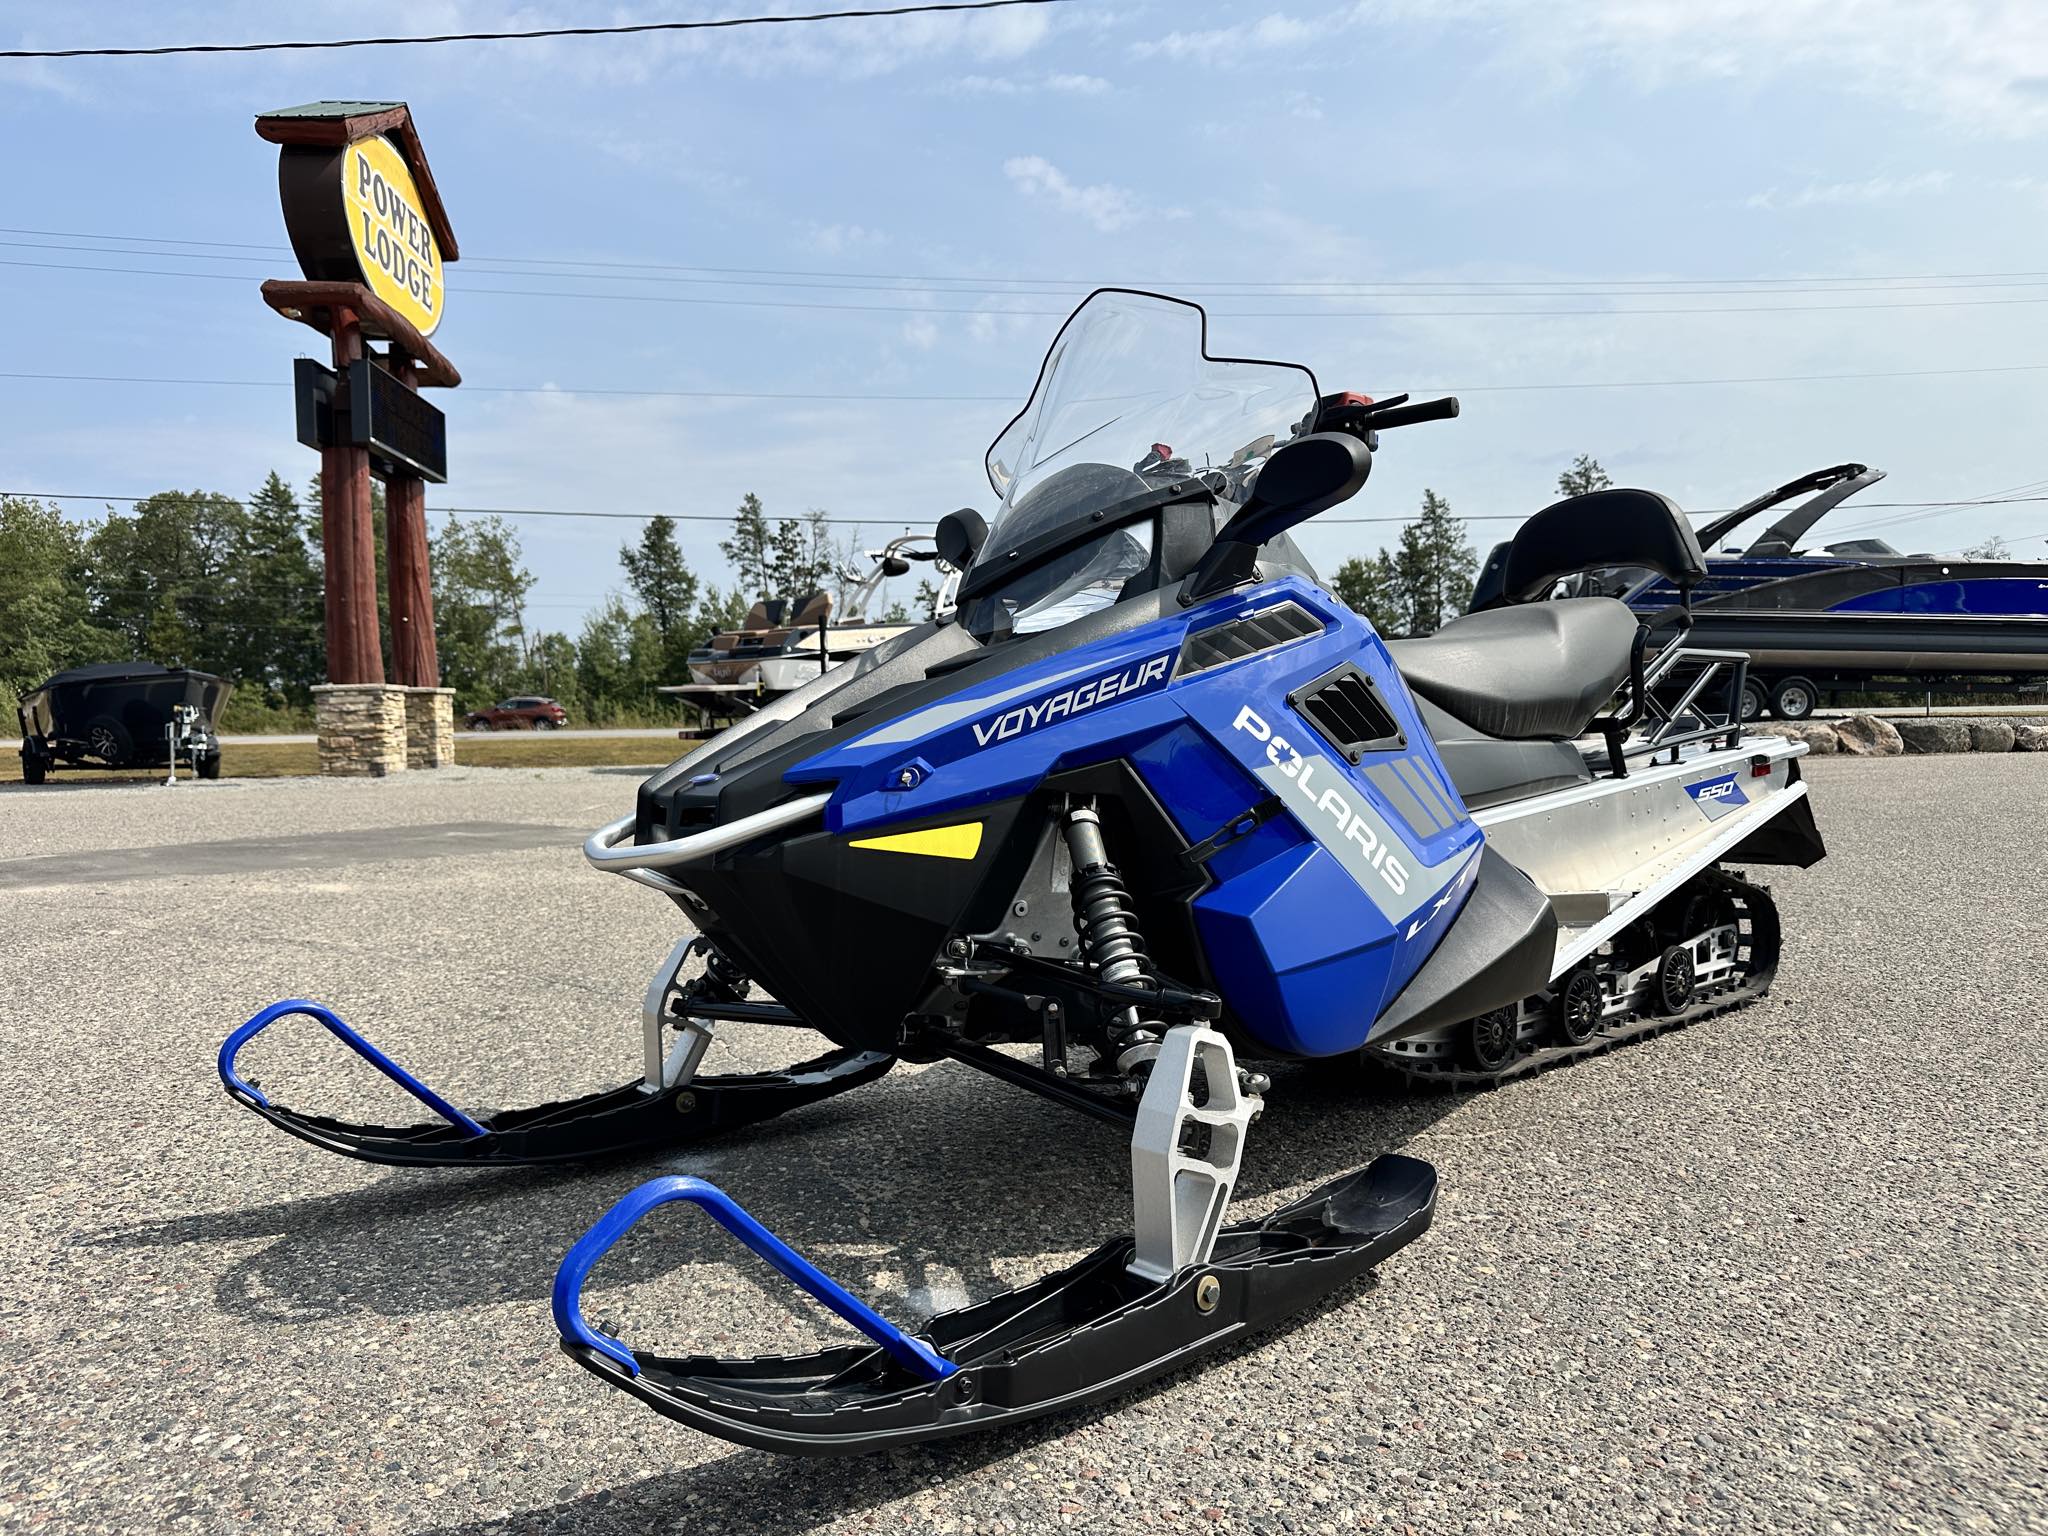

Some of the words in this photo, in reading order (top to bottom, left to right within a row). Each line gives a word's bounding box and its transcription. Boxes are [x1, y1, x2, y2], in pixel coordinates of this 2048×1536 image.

[357, 152, 433, 268] POWER
[362, 210, 433, 312] LODGE
[972, 654, 1170, 747] VOYAGEUR
[1232, 704, 1410, 896] POLARIS
[1694, 780, 1735, 803] 550
[1405, 860, 1474, 942] LXT
